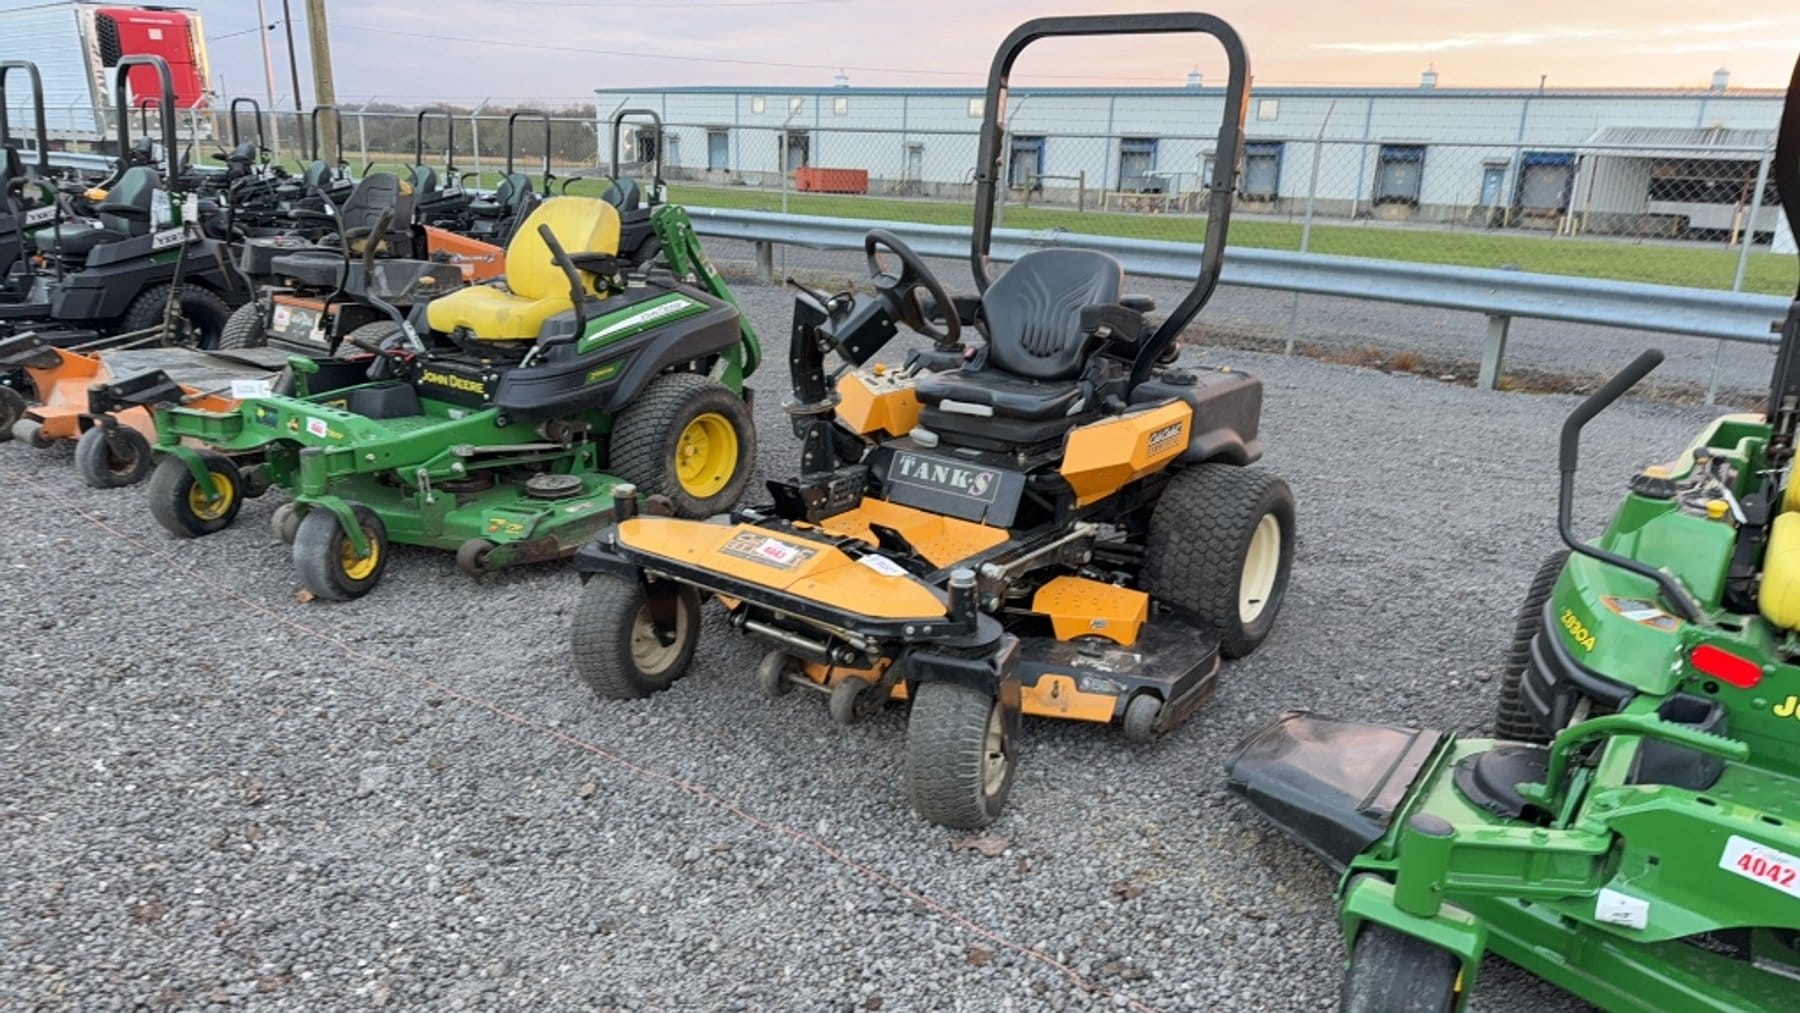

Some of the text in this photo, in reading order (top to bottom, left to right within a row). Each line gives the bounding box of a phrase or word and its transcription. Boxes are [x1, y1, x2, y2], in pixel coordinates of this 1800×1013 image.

[421, 370, 488, 395] JOHN DEERE
[1736, 853, 1797, 888] 4042
